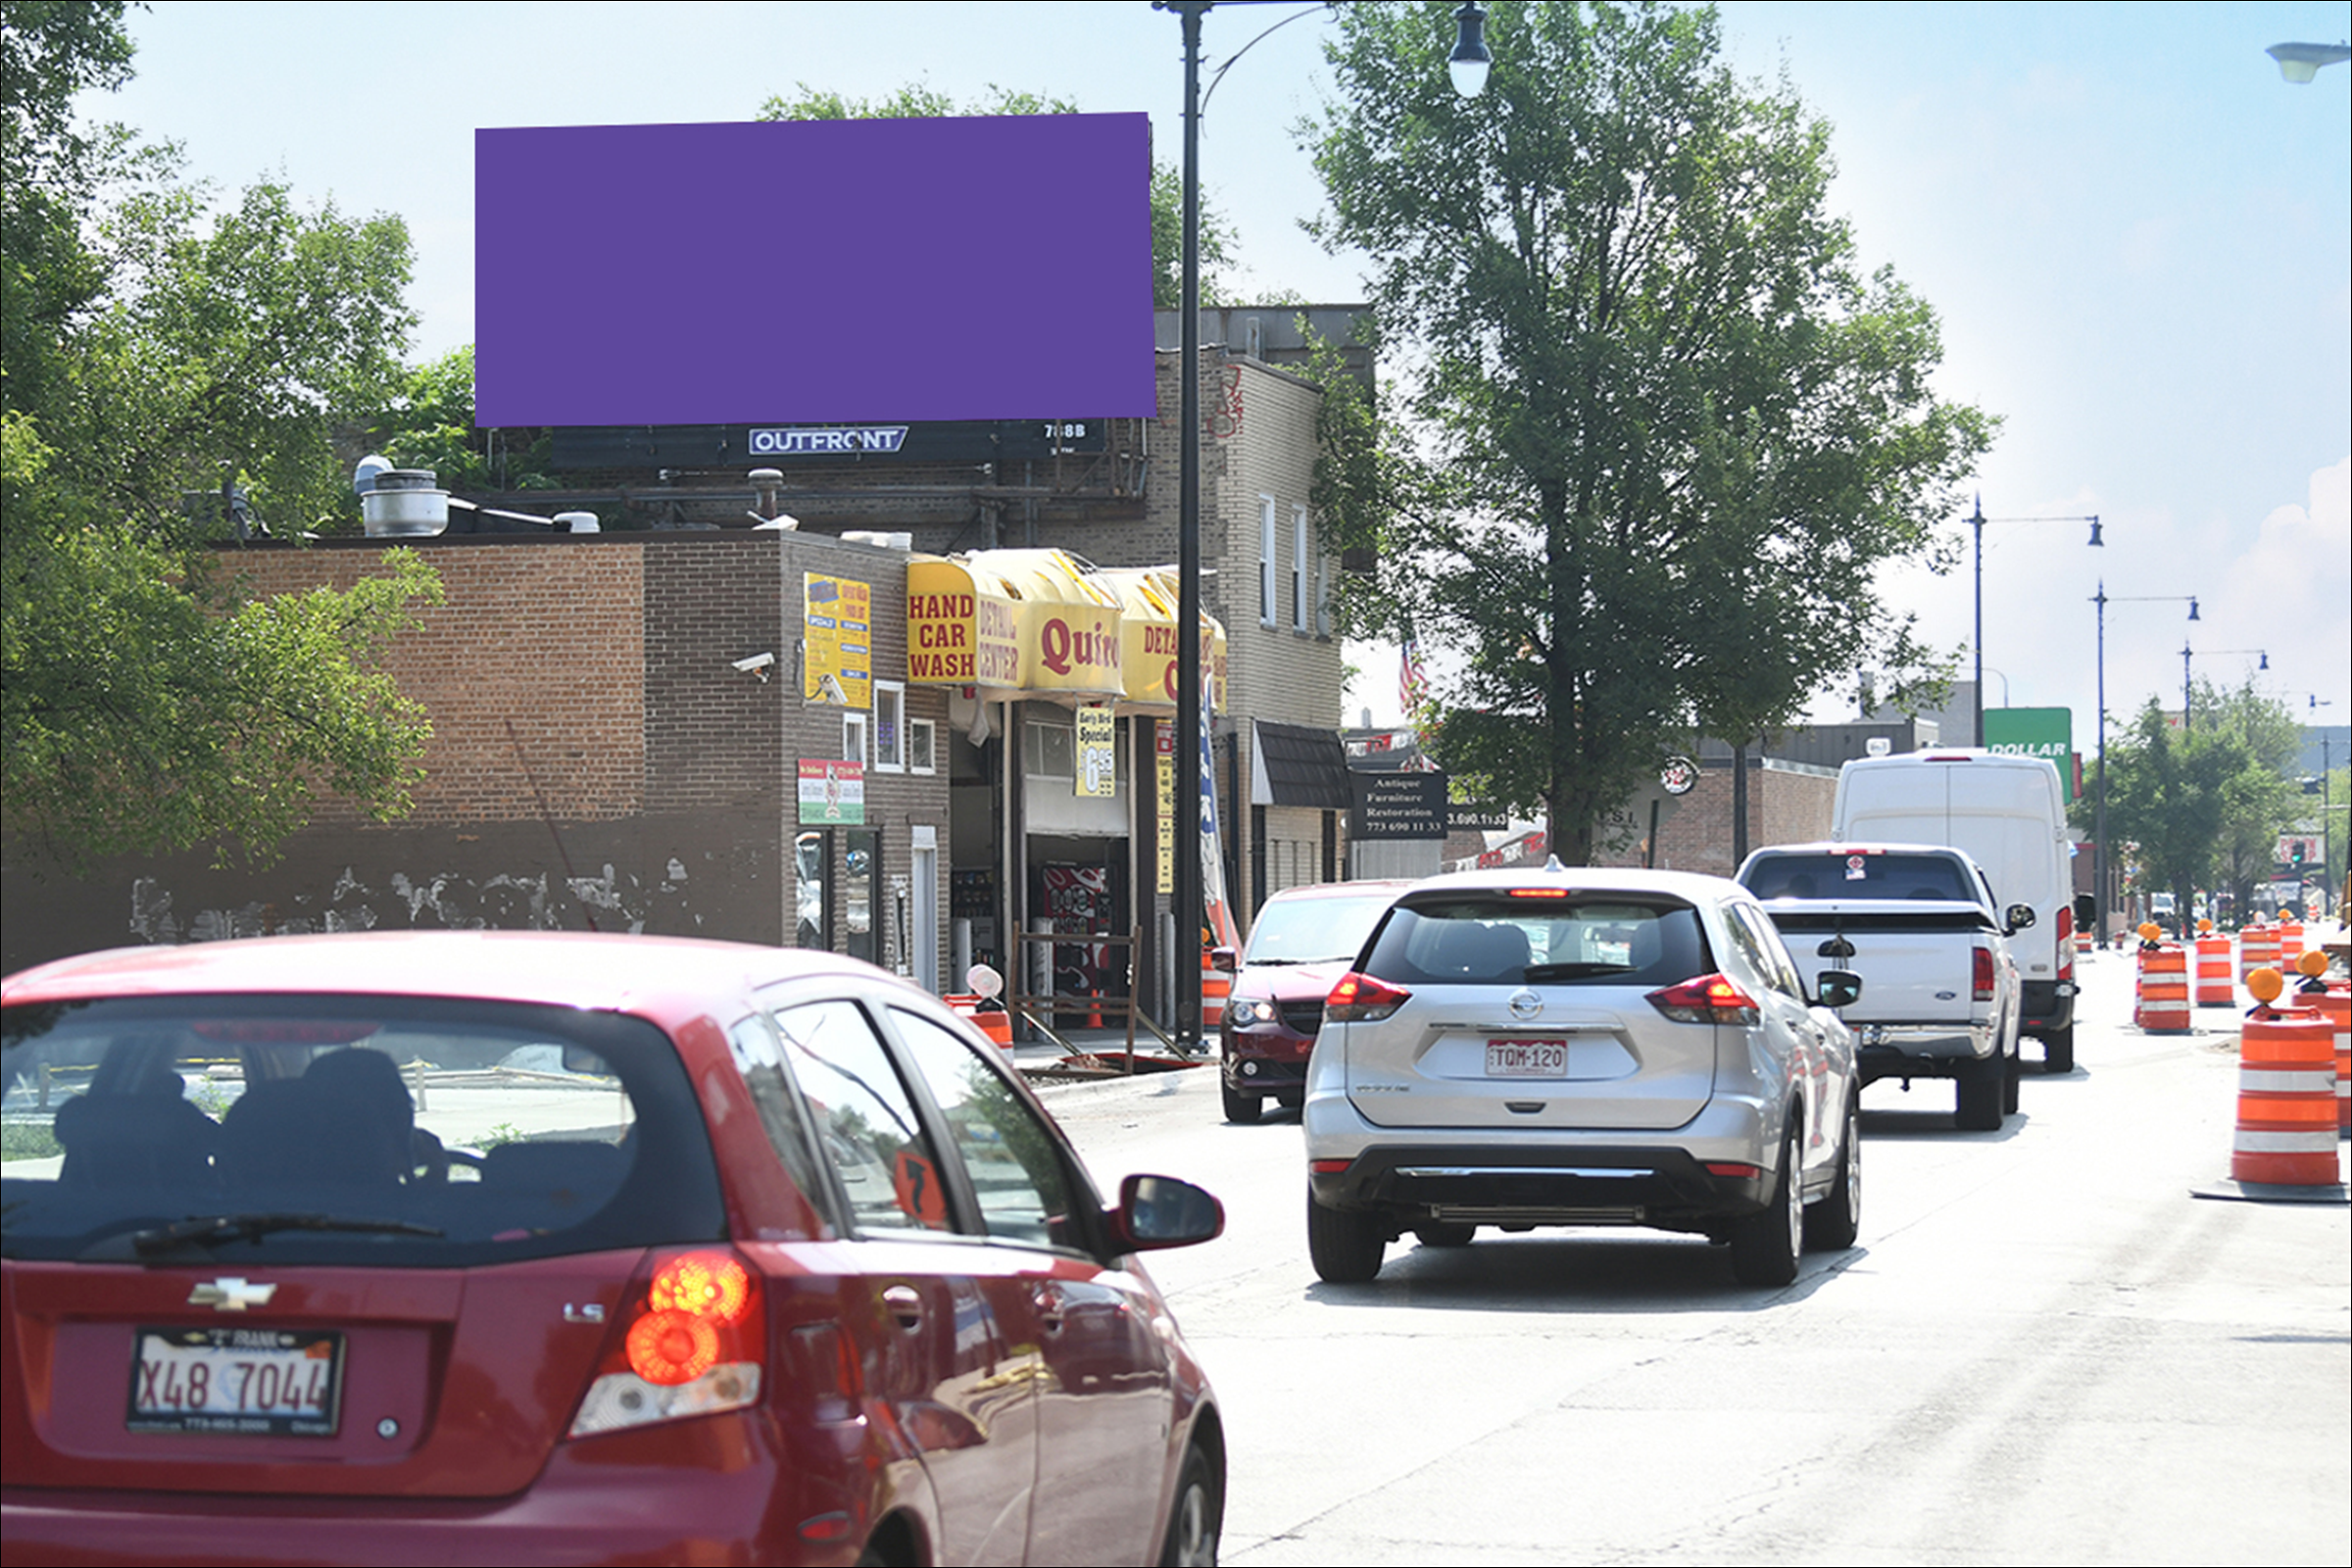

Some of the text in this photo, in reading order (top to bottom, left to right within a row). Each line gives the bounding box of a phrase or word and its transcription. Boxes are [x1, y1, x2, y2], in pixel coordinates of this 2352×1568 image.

[755, 431, 899, 451] OUTFRONT
[908, 594, 974, 619] HAND
[919, 623, 965, 648] CAR
[909, 653, 975, 677] WASH
[1080, 727, 1111, 744] Special
[1990, 743, 2066, 756] DOLLAR
[1375, 779, 1421, 789] Antique
[1367, 794, 1423, 803] Furniture
[1367, 808, 1433, 817] Restoration
[1367, 822, 1386, 831] 773
[1389, 822, 1409, 831] 690
[564, 1302, 604, 1323] LS
[235, 1362, 327, 1410] 7044
